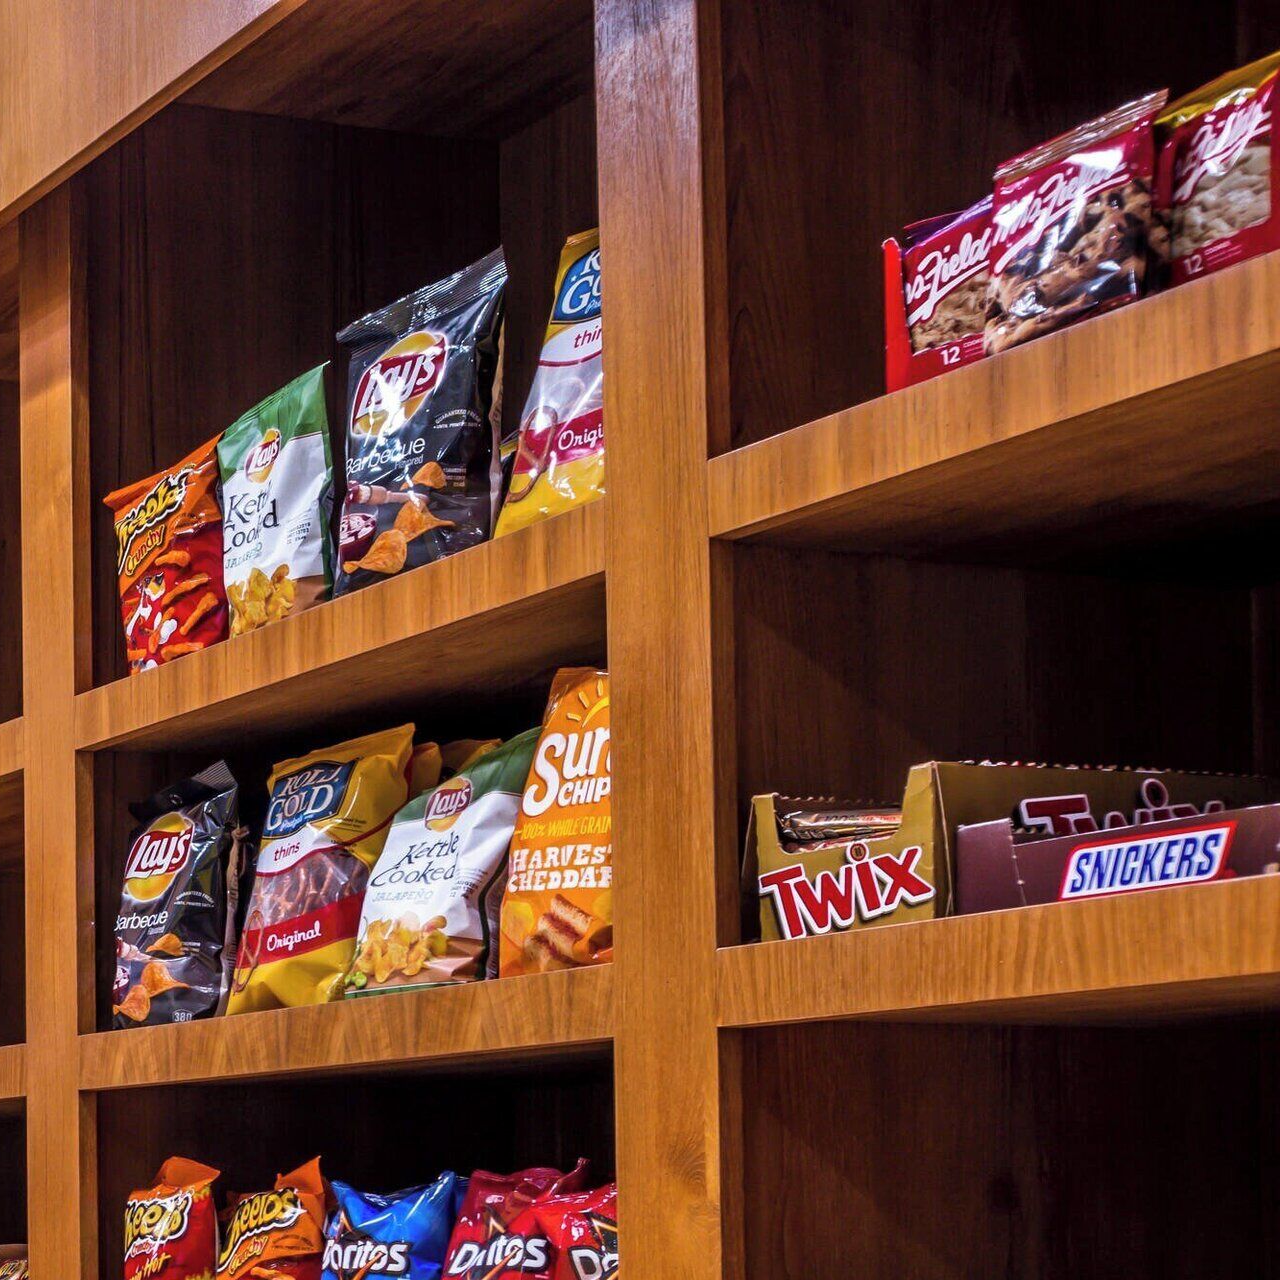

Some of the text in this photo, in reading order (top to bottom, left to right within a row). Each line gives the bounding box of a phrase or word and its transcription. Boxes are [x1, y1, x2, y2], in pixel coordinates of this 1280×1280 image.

[1183, 255, 1204, 275] 12
[942, 346, 961, 366] 12
[558, 423, 603, 456] Origi
[346, 437, 426, 476] Barbecue
[126, 524, 165, 576] Crunchy
[266, 783, 335, 831] GOLD
[557, 776, 611, 807] CHIP
[547, 817, 579, 839] WHOLE
[125, 828, 191, 880] Lay's
[273, 840, 301, 862] thins
[396, 830, 459, 866] Kettle
[1069, 832, 1223, 895] SNICKERS
[370, 852, 459, 888] Cooked
[266, 920, 322, 951] Original
[173, 1011, 193, 1022] 380
[143, 1253, 172, 1279] Hot
[450, 1237, 548, 1275] Doritos
